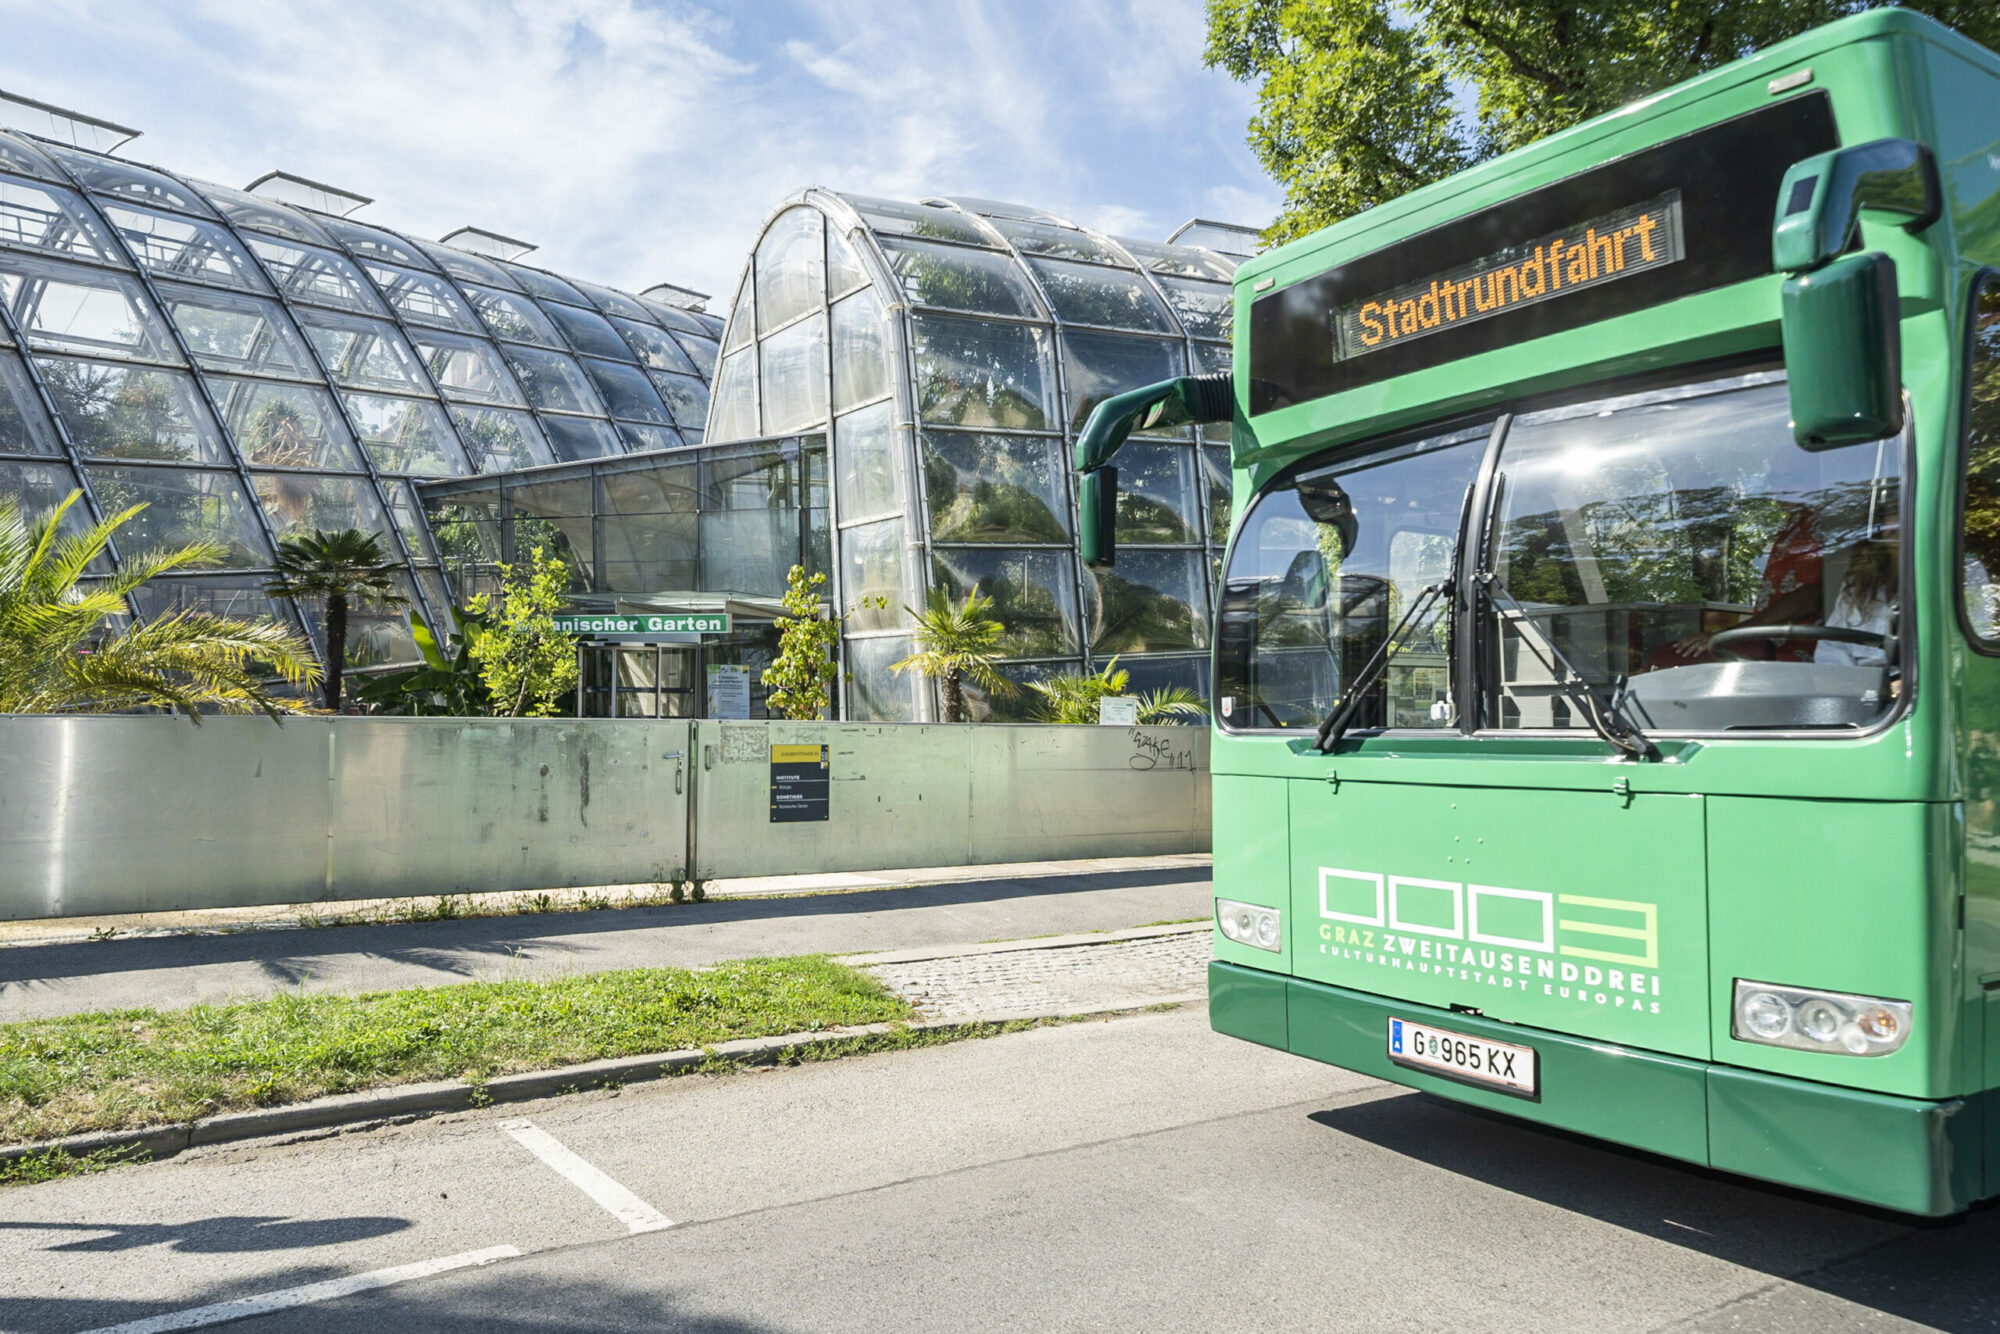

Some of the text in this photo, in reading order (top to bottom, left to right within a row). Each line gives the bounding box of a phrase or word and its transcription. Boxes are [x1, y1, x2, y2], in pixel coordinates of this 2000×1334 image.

[1359, 214, 1656, 346] Stadtrundfahrt
[648, 617, 721, 631] Garten
[1319, 924, 1660, 996] GRAZ ZWEITAUSENDDREI
[1320, 944, 1661, 1014] KULTURHAUPTSTADT EUROPAS
